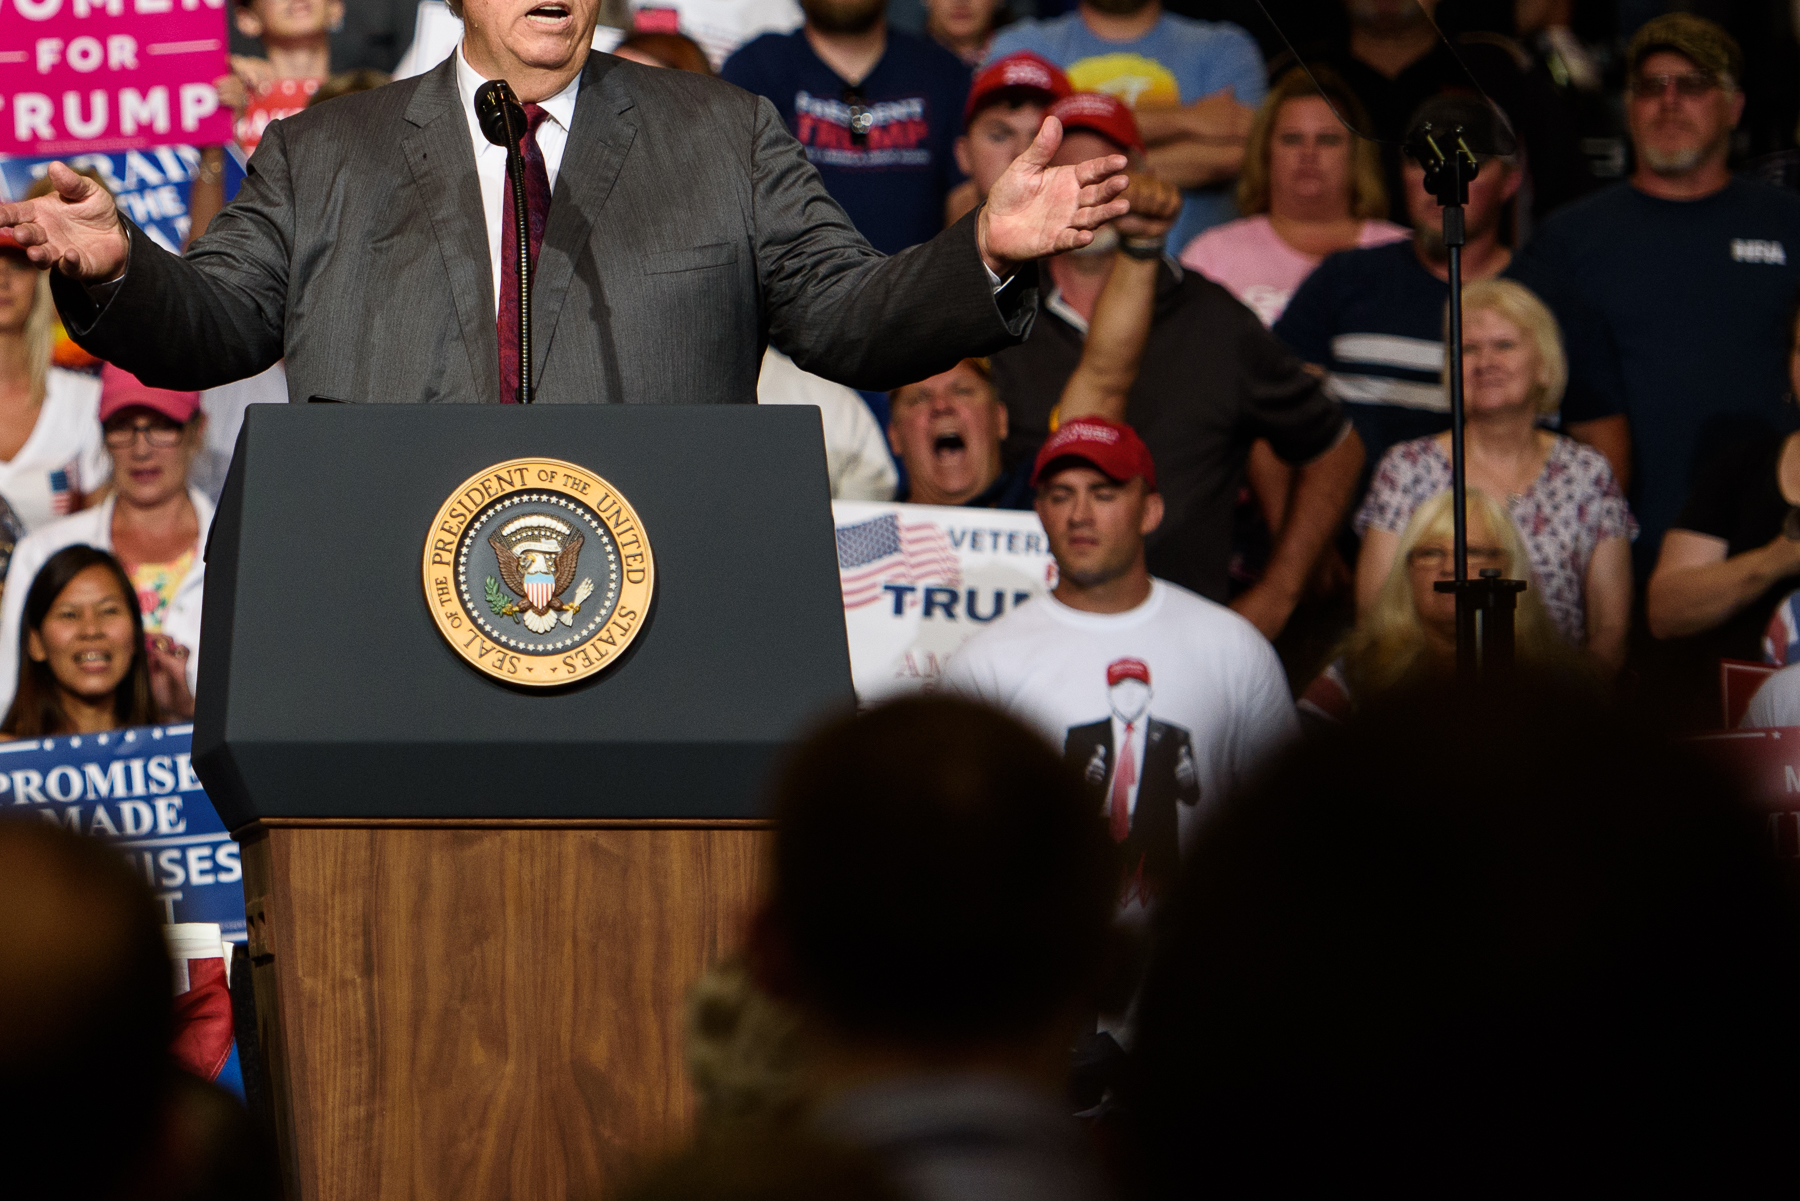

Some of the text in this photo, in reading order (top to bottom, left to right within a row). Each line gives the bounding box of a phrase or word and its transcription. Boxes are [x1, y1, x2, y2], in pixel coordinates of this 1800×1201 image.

[35, 33, 141, 75] FOR
[1729, 237, 1787, 266] NRA
[432, 467, 647, 675] SEAL OF THE PRESIDENT OF THE UNITED STATES
